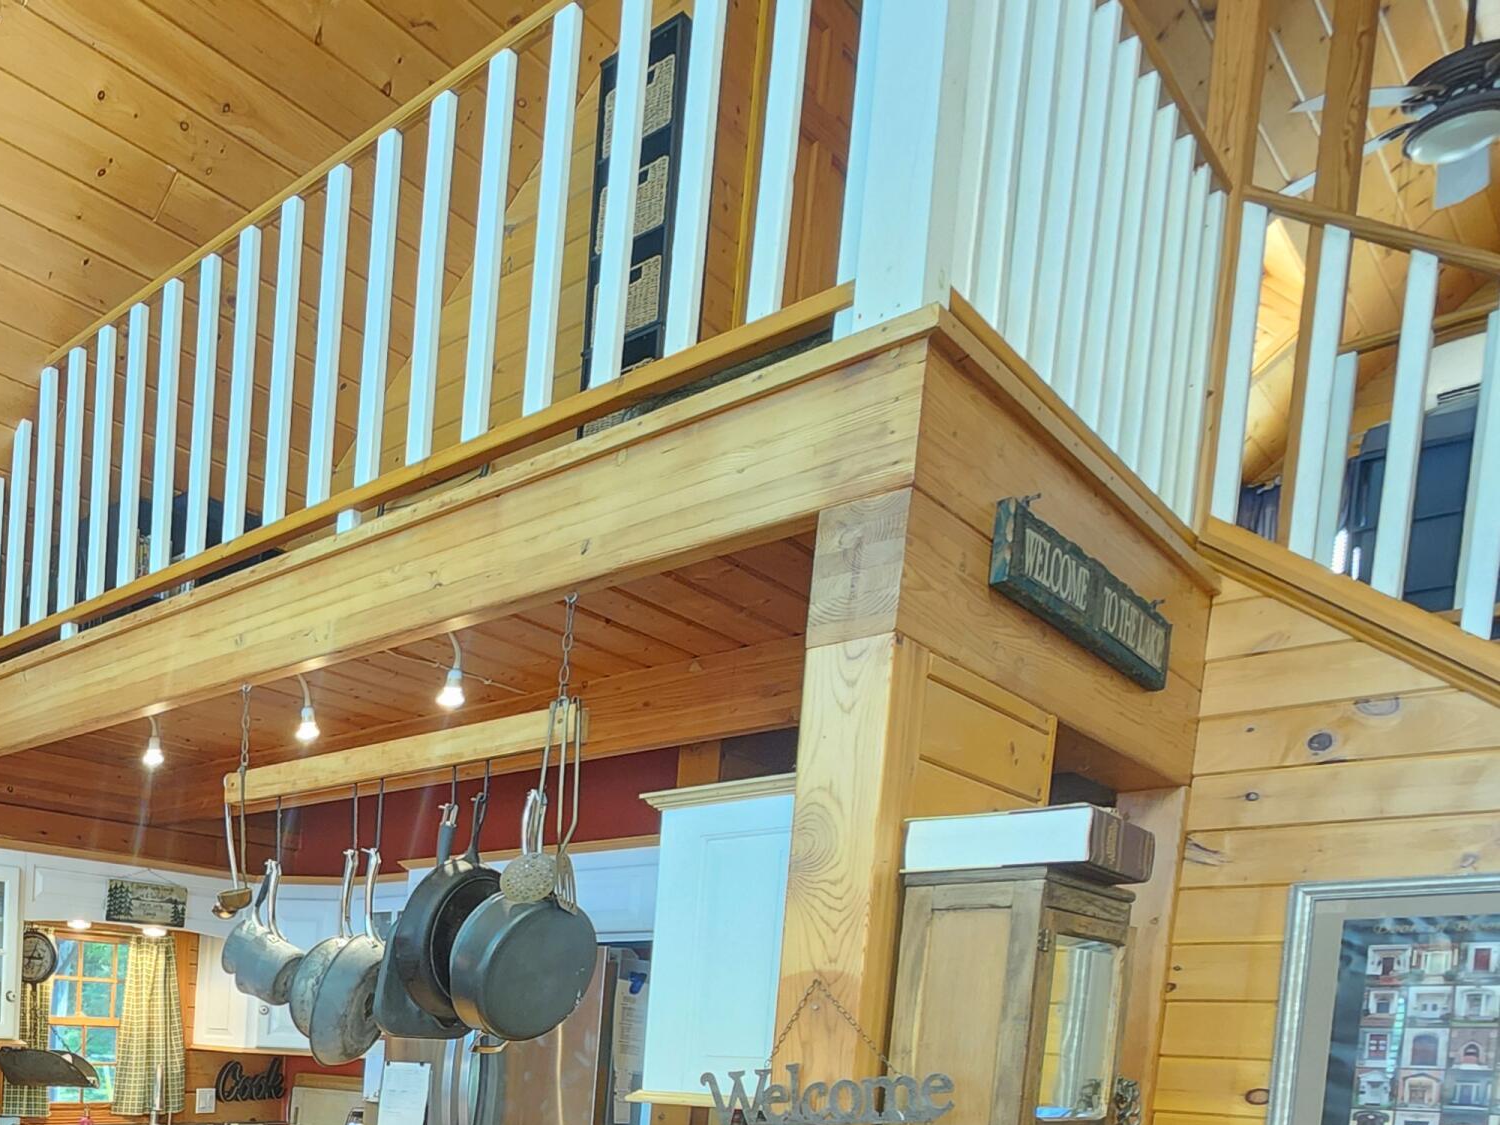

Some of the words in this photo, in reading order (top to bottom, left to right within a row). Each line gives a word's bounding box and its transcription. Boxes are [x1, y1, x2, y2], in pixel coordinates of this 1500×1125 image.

[1025, 527, 1090, 612] WELCOME
[1102, 586, 1119, 633] TO
[1118, 598, 1140, 648] THE
[216, 1055, 285, 1103] Cook
